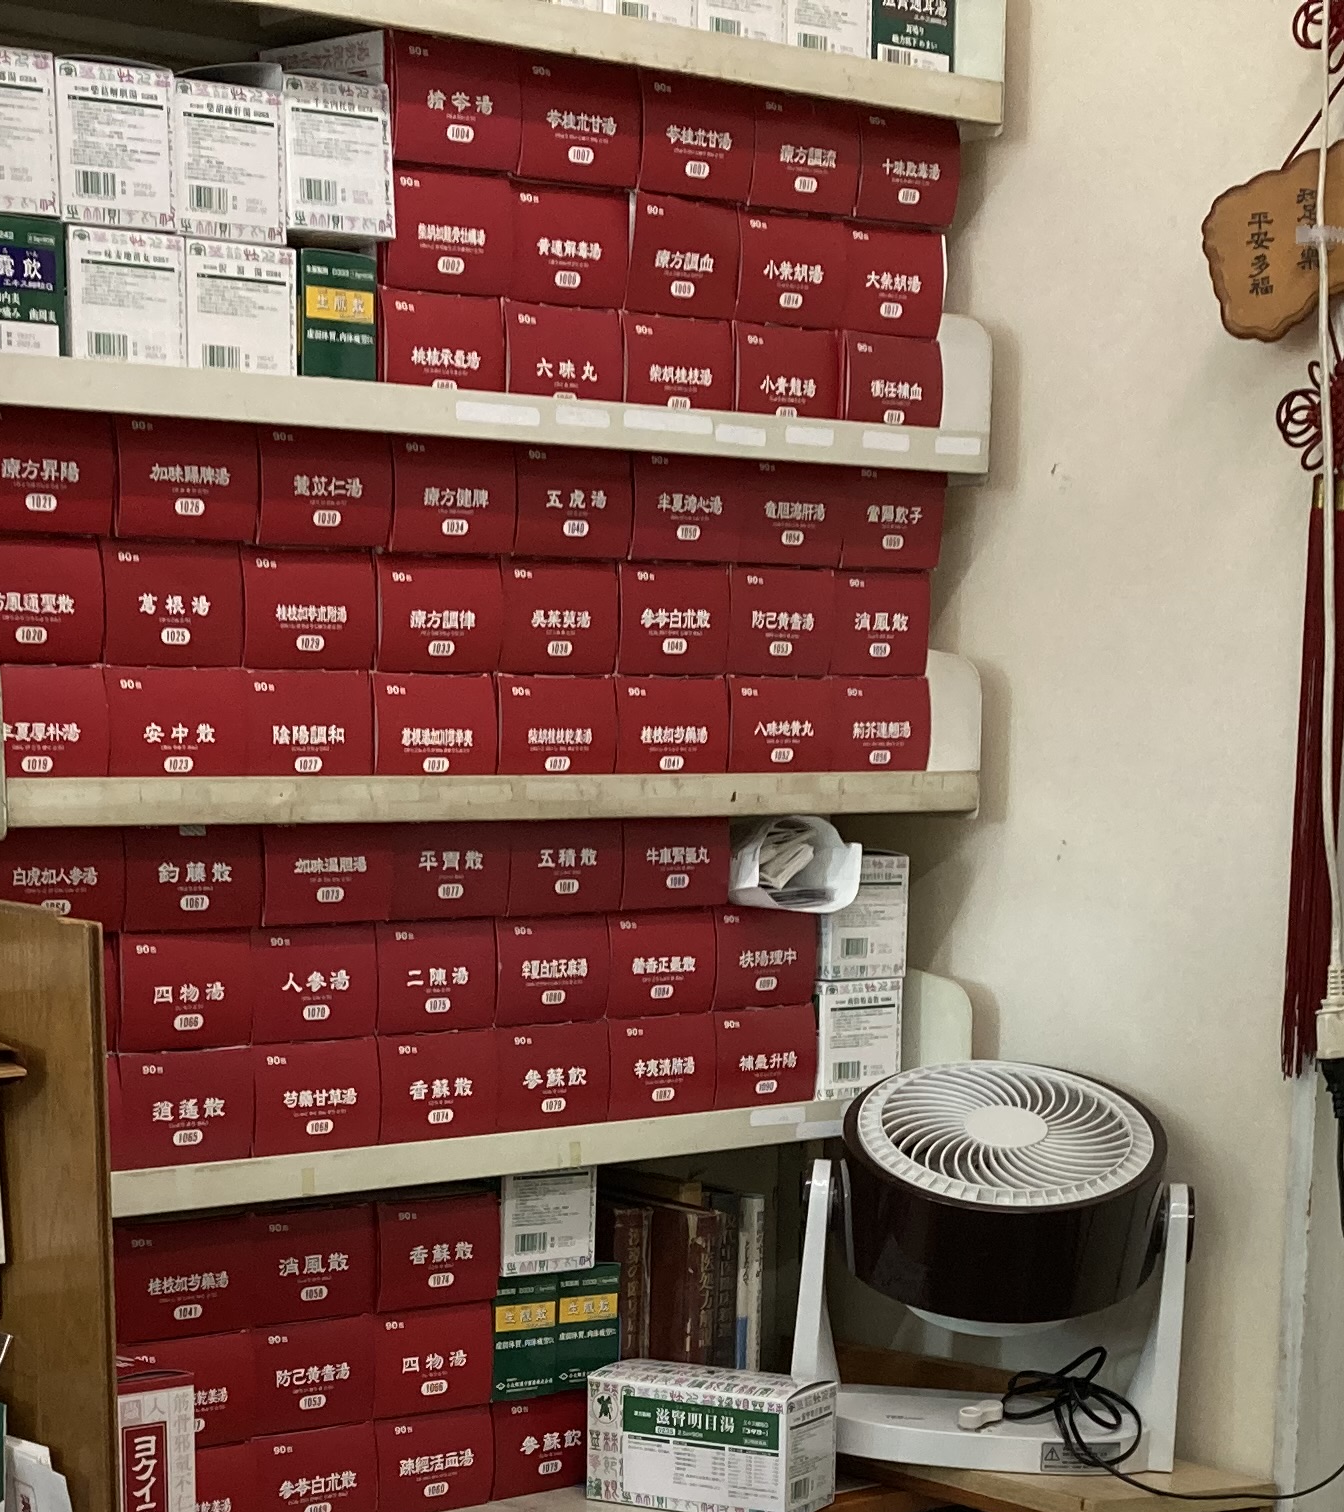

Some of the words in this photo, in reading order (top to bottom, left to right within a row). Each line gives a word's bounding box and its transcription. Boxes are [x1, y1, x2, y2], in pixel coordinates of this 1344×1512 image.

[449, 126, 471, 140] 1004
[570, 148, 592, 162] 1007
[1246, 211, 1275, 296] 平安多福
[32, 495, 53, 508] 1021
[545, 488, 607, 511] 五虎湯
[317, 512, 337, 524] 1030
[22, 629, 43, 641] 1020
[164, 630, 186, 643] 1025
[143, 722, 216, 745] 安中散
[168, 758, 189, 770] 1023
[184, 896, 205, 909] 1067
[406, 966, 470, 988] 二陳湯
[153, 982, 226, 1005] 四物湯
[179, 1017, 199, 1029] 1066
[401, 1349, 468, 1375] 四物湯
